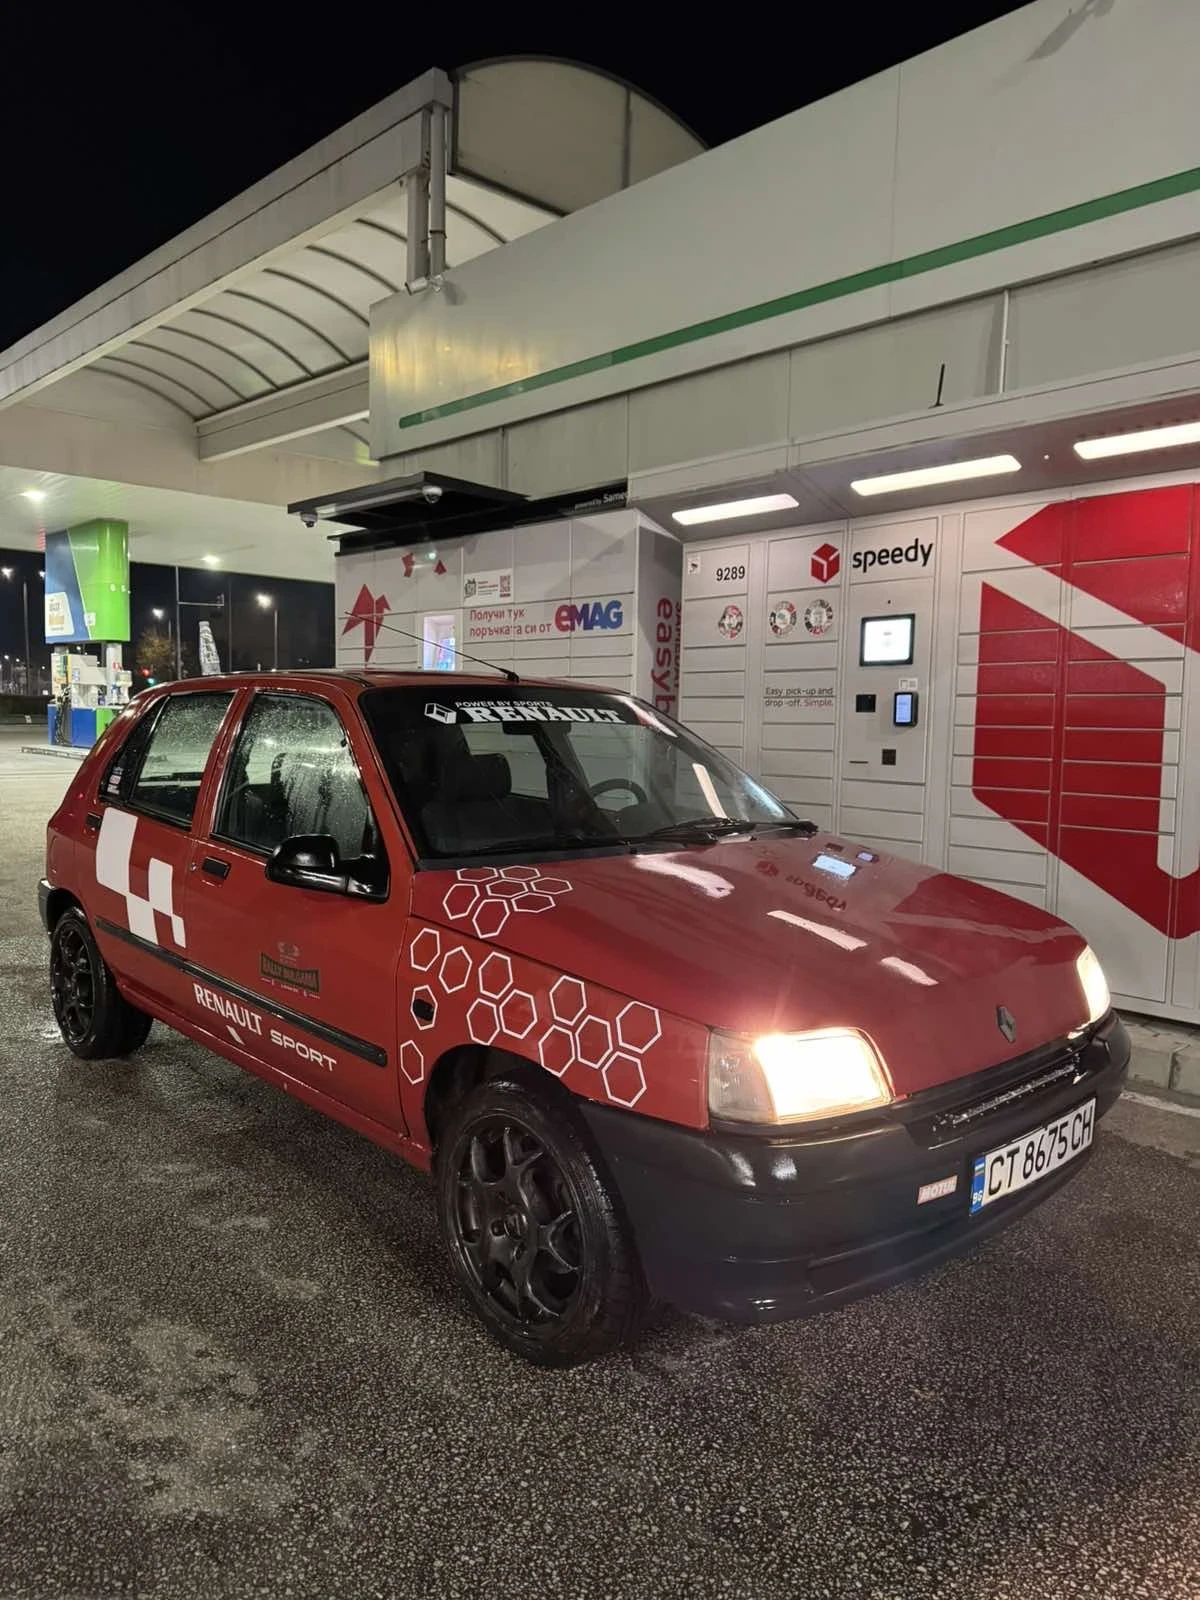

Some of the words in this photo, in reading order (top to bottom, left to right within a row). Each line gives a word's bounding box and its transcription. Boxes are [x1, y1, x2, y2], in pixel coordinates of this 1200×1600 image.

[852, 538, 934, 573] speedy
[716, 565, 746, 582] 9289
[470, 608, 505, 622] Получи
[508, 608, 525, 621] тук
[470, 624, 523, 639] поръчката
[525, 624, 537, 635] си
[539, 623, 552, 634] от
[555, 600, 623, 632] eMAG
[765, 687, 784, 697] Easy
[786, 687, 816, 697] pick-up
[818, 687, 834, 696] and
[455, 700, 494, 708] POWER
[460, 705, 626, 724] RENAULT
[193, 982, 263, 1036] RENAULT
[269, 1028, 337, 1072] SPORT
[988, 1148, 1020, 1197] CT
[1022, 1121, 1070, 1181] 8675
[1071, 1105, 1094, 1152] CH
[972, 1189, 984, 1206] BG
